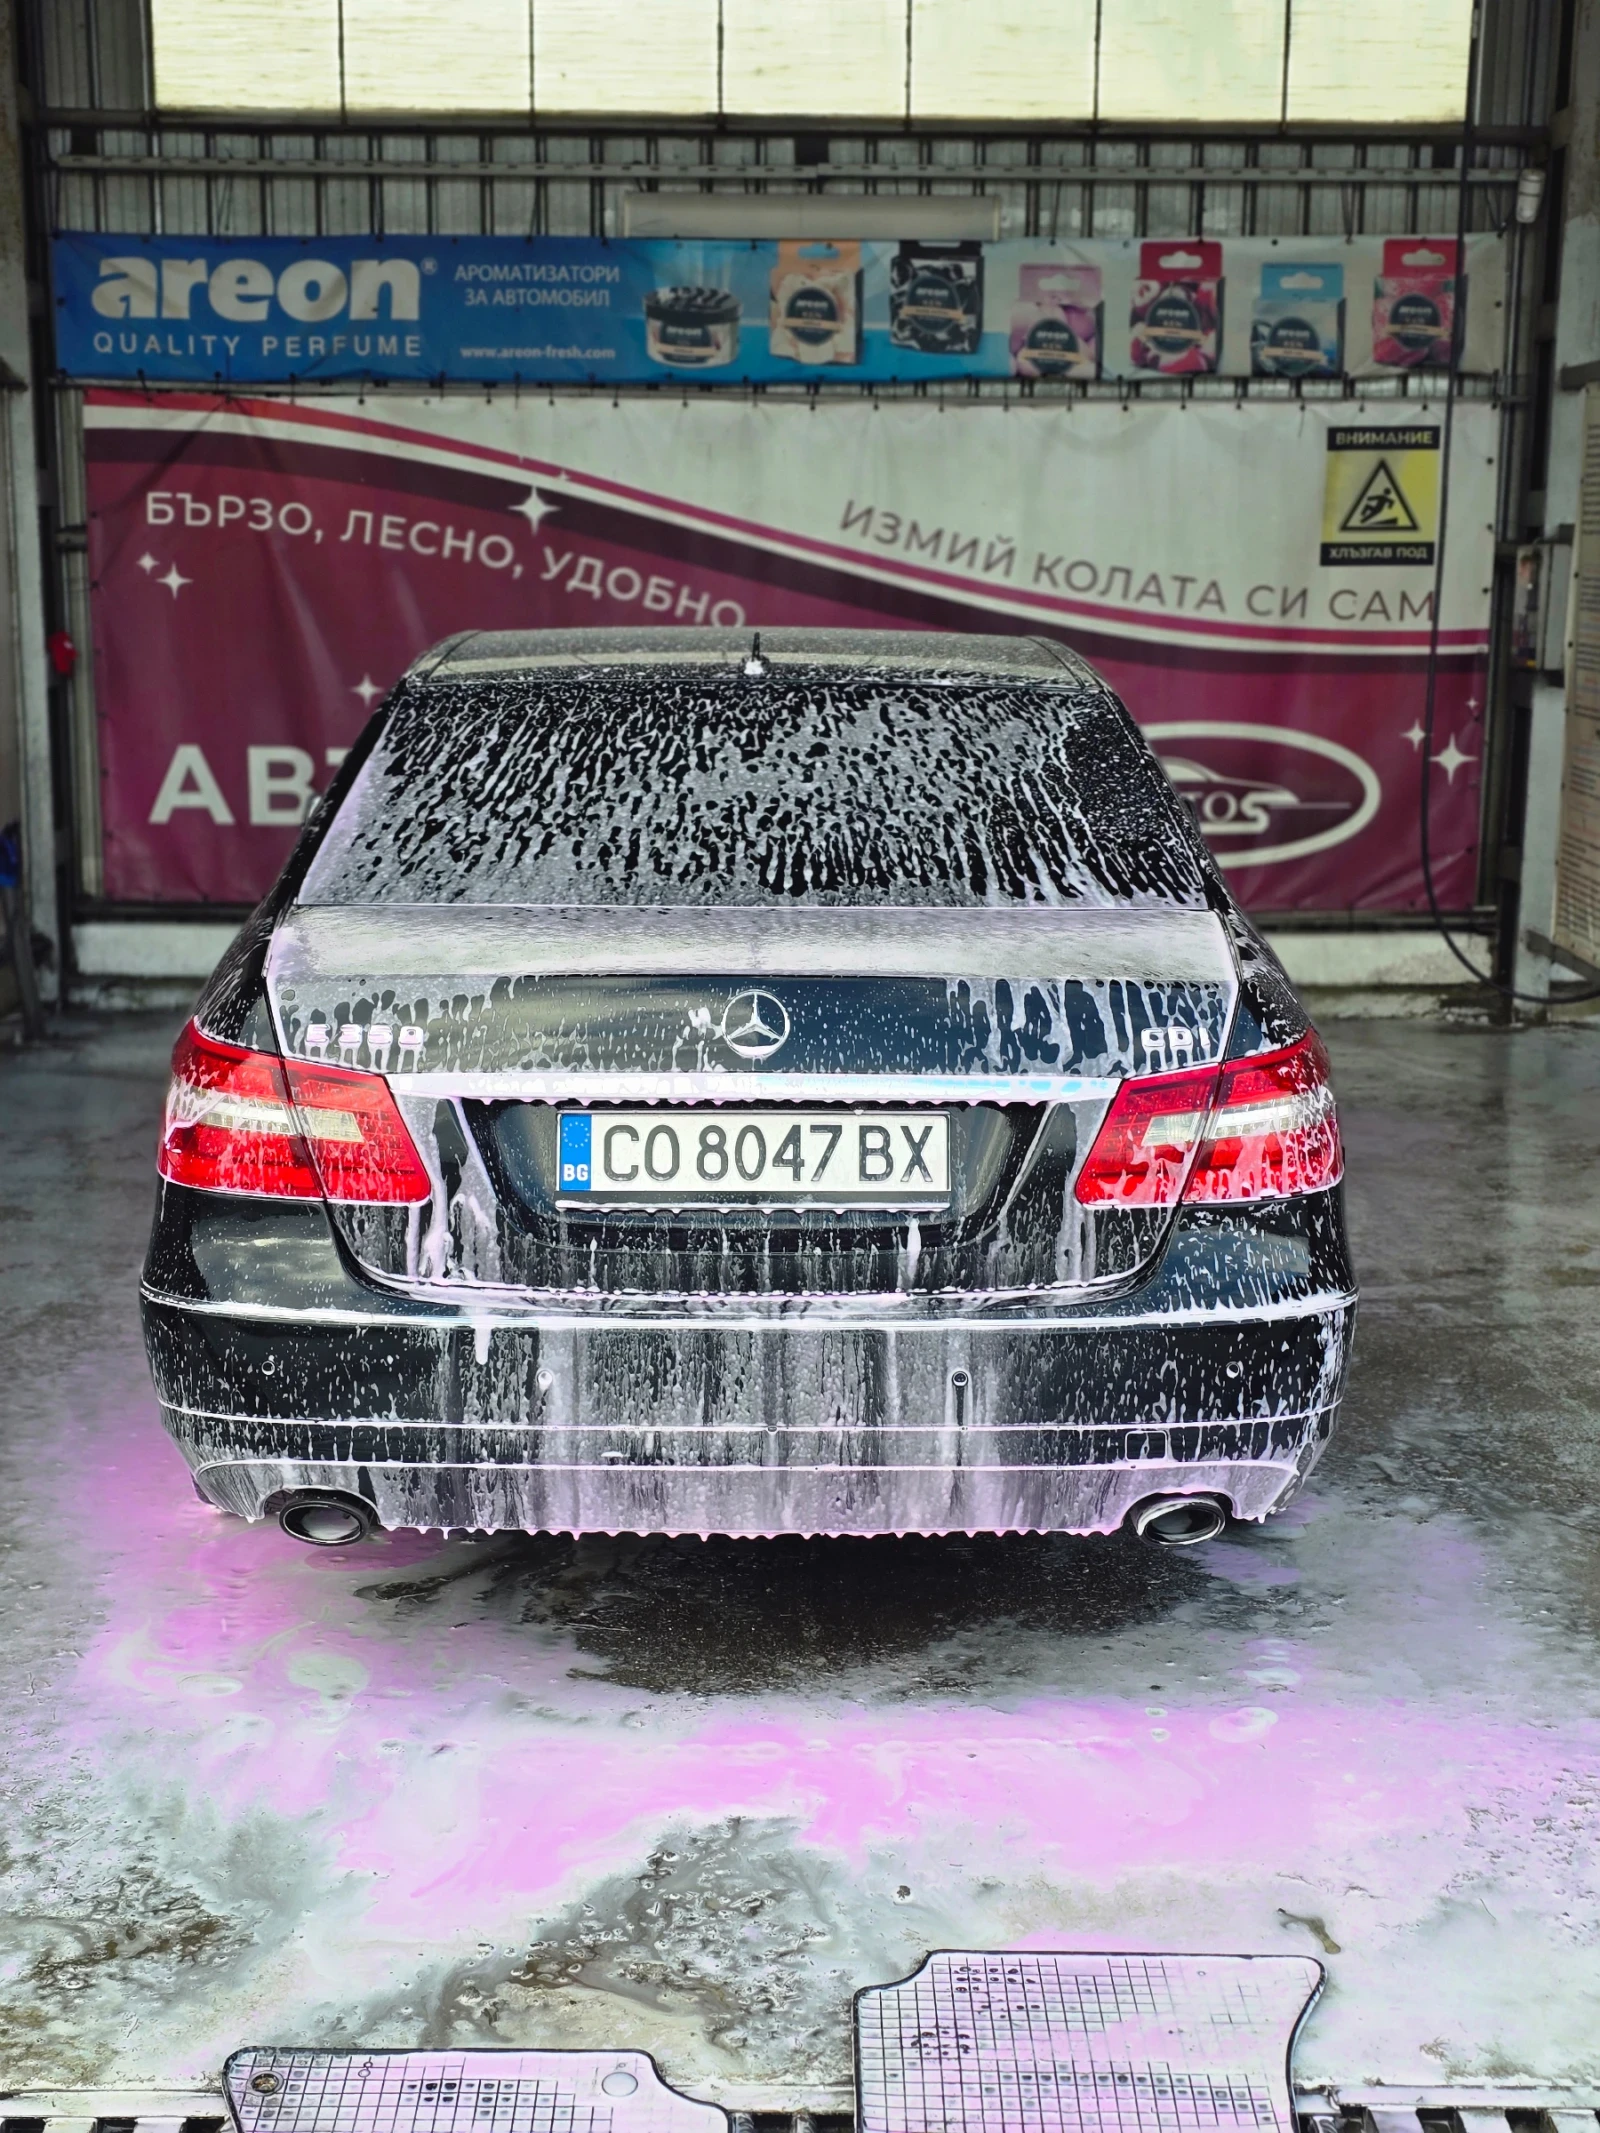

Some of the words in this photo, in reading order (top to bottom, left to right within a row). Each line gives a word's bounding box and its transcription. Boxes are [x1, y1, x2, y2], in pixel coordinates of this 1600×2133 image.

[454, 265, 621, 283] АРОМАТИЗАТОРИ
[465, 289, 490, 306] ЗА
[494, 289, 612, 308] АВТОМОБИЛ
[93, 332, 240, 356] QUALITY
[262, 336, 421, 357] PERFUME
[459, 345, 616, 360] www.areon-fresh.com
[1335, 430, 1434, 445] ВНИМАНИЕ
[145, 491, 325, 543] БЪРЗО,
[340, 509, 525, 579] ЛЕСНО,
[540, 546, 746, 627] УДОБНО
[838, 499, 1018, 580] ИЗМИЙ
[1032, 550, 1228, 615] КОЛАТА
[1246, 585, 1309, 618] СИ
[1328, 590, 1436, 622] САМ
[1328, 547, 1393, 559] ХЛЪЗГАВ
[1396, 547, 1428, 560] ПОД
[695, 1124, 843, 1182] 8047
[563, 1163, 589, 1182] BG
